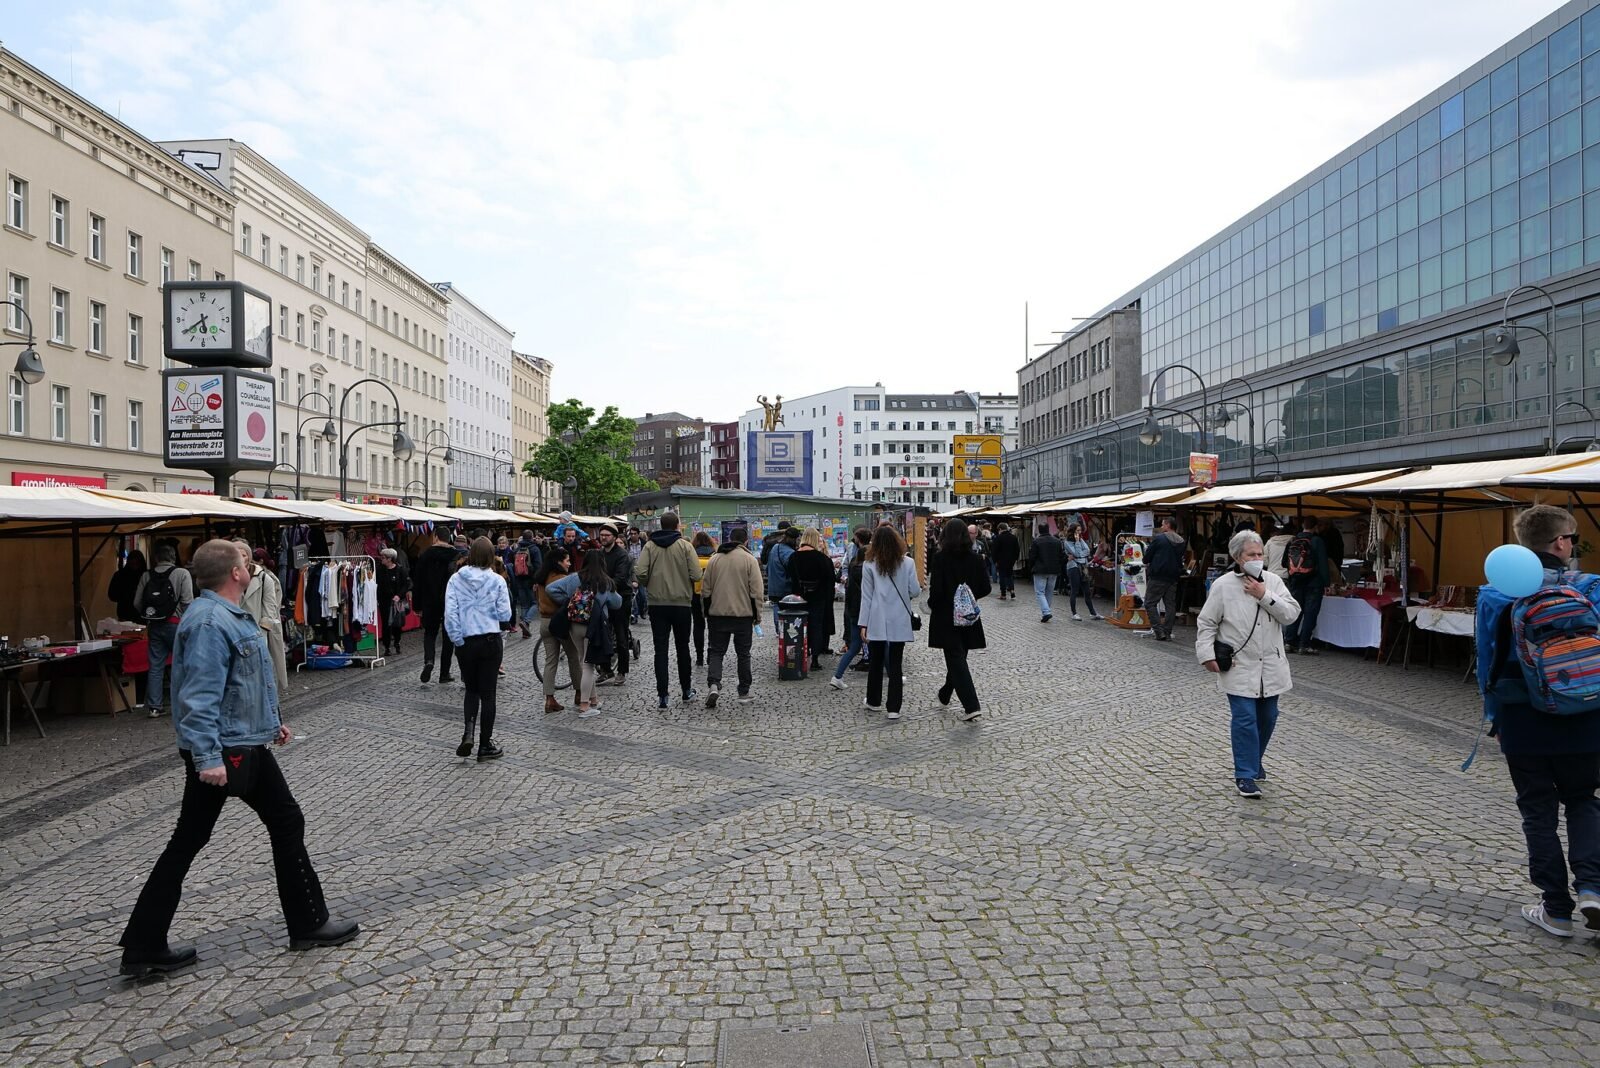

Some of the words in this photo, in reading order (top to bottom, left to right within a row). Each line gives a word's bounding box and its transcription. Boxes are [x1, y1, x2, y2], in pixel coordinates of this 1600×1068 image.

[245, 382, 265, 391] THERAPY
[240, 392, 271, 402] COUNSELLING
[170, 431, 180, 439] Am
[181, 431, 223, 439] Hermannplatz
[170, 442, 209, 450] Weserstraße
[771, 442, 788, 458] B
